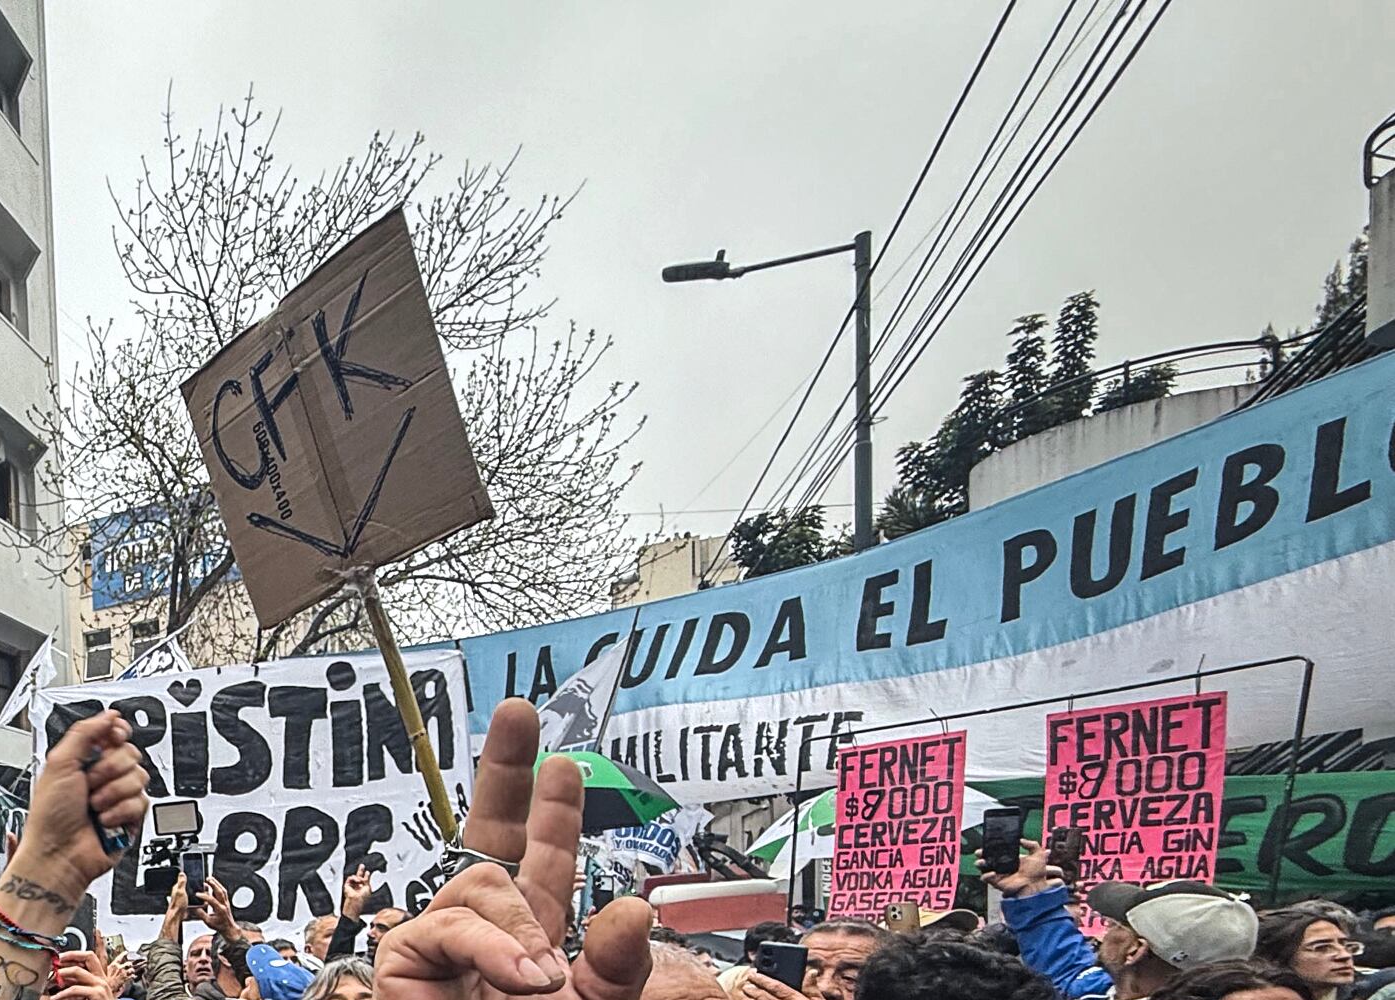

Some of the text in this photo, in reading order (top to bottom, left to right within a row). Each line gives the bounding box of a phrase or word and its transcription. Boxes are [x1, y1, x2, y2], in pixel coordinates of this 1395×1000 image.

[212, 269, 413, 490] CFK
[505, 645, 557, 705] LA
[856, 559, 948, 652] EL
[1000, 416, 1395, 624] PUEBL
[1050, 697, 1222, 765] FERNET
[839, 736, 962, 792] FERNET
[837, 816, 956, 849] CERVEZA
[1047, 792, 1214, 832] CERVEZA
[110, 802, 395, 923] LBRE
[835, 868, 953, 891] VODKA AGUA
[1078, 854, 1210, 880] DKA AGUA
